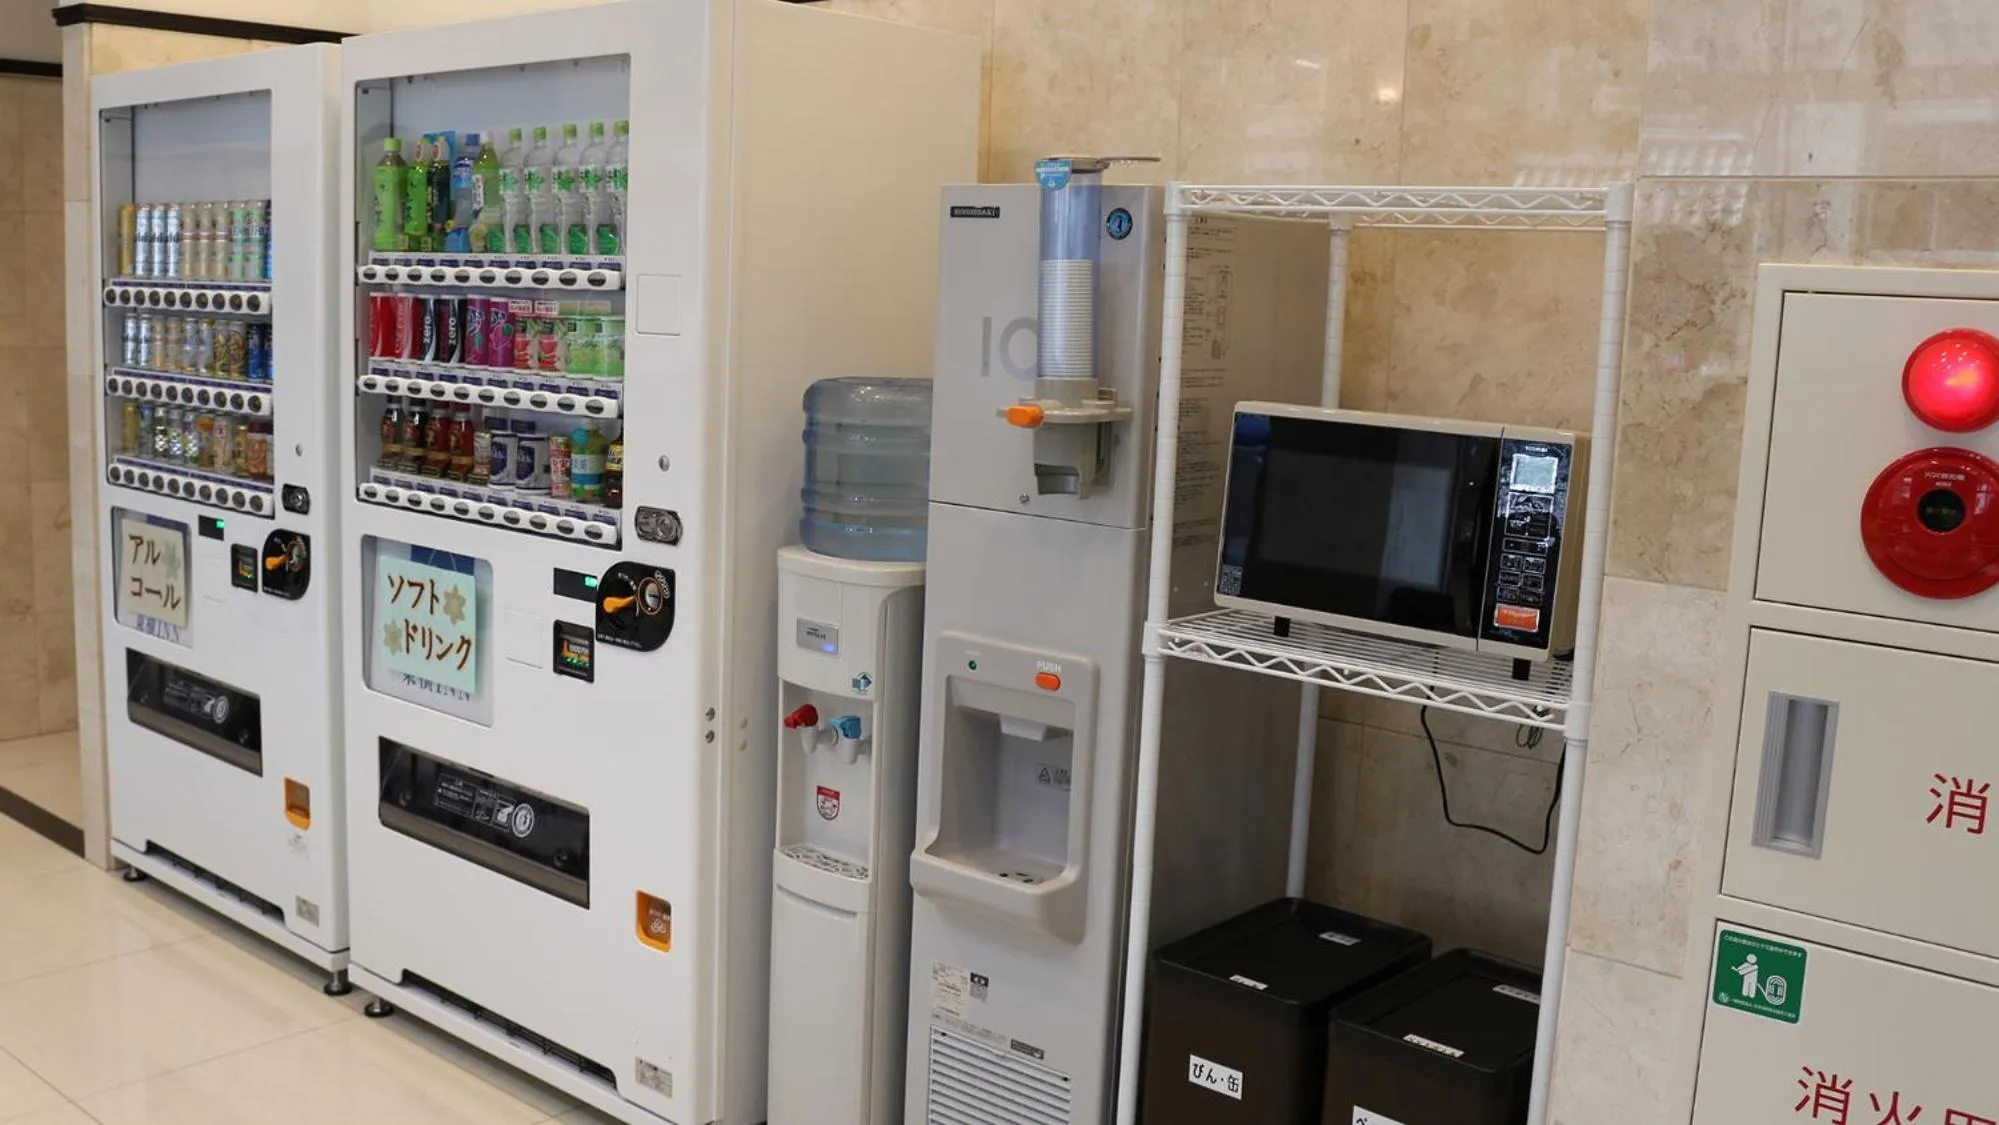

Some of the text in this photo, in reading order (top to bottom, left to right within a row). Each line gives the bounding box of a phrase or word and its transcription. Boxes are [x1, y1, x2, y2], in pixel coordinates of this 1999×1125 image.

[129, 533, 161, 566] アル
[130, 575, 181, 611] コール
[387, 574, 440, 616] ソフト
[403, 617, 473, 672] ドリンク
[1036, 659, 1062, 673] PUSH
[1926, 773, 1991, 834] 消
[1192, 1062, 1240, 1093] びん・缶
